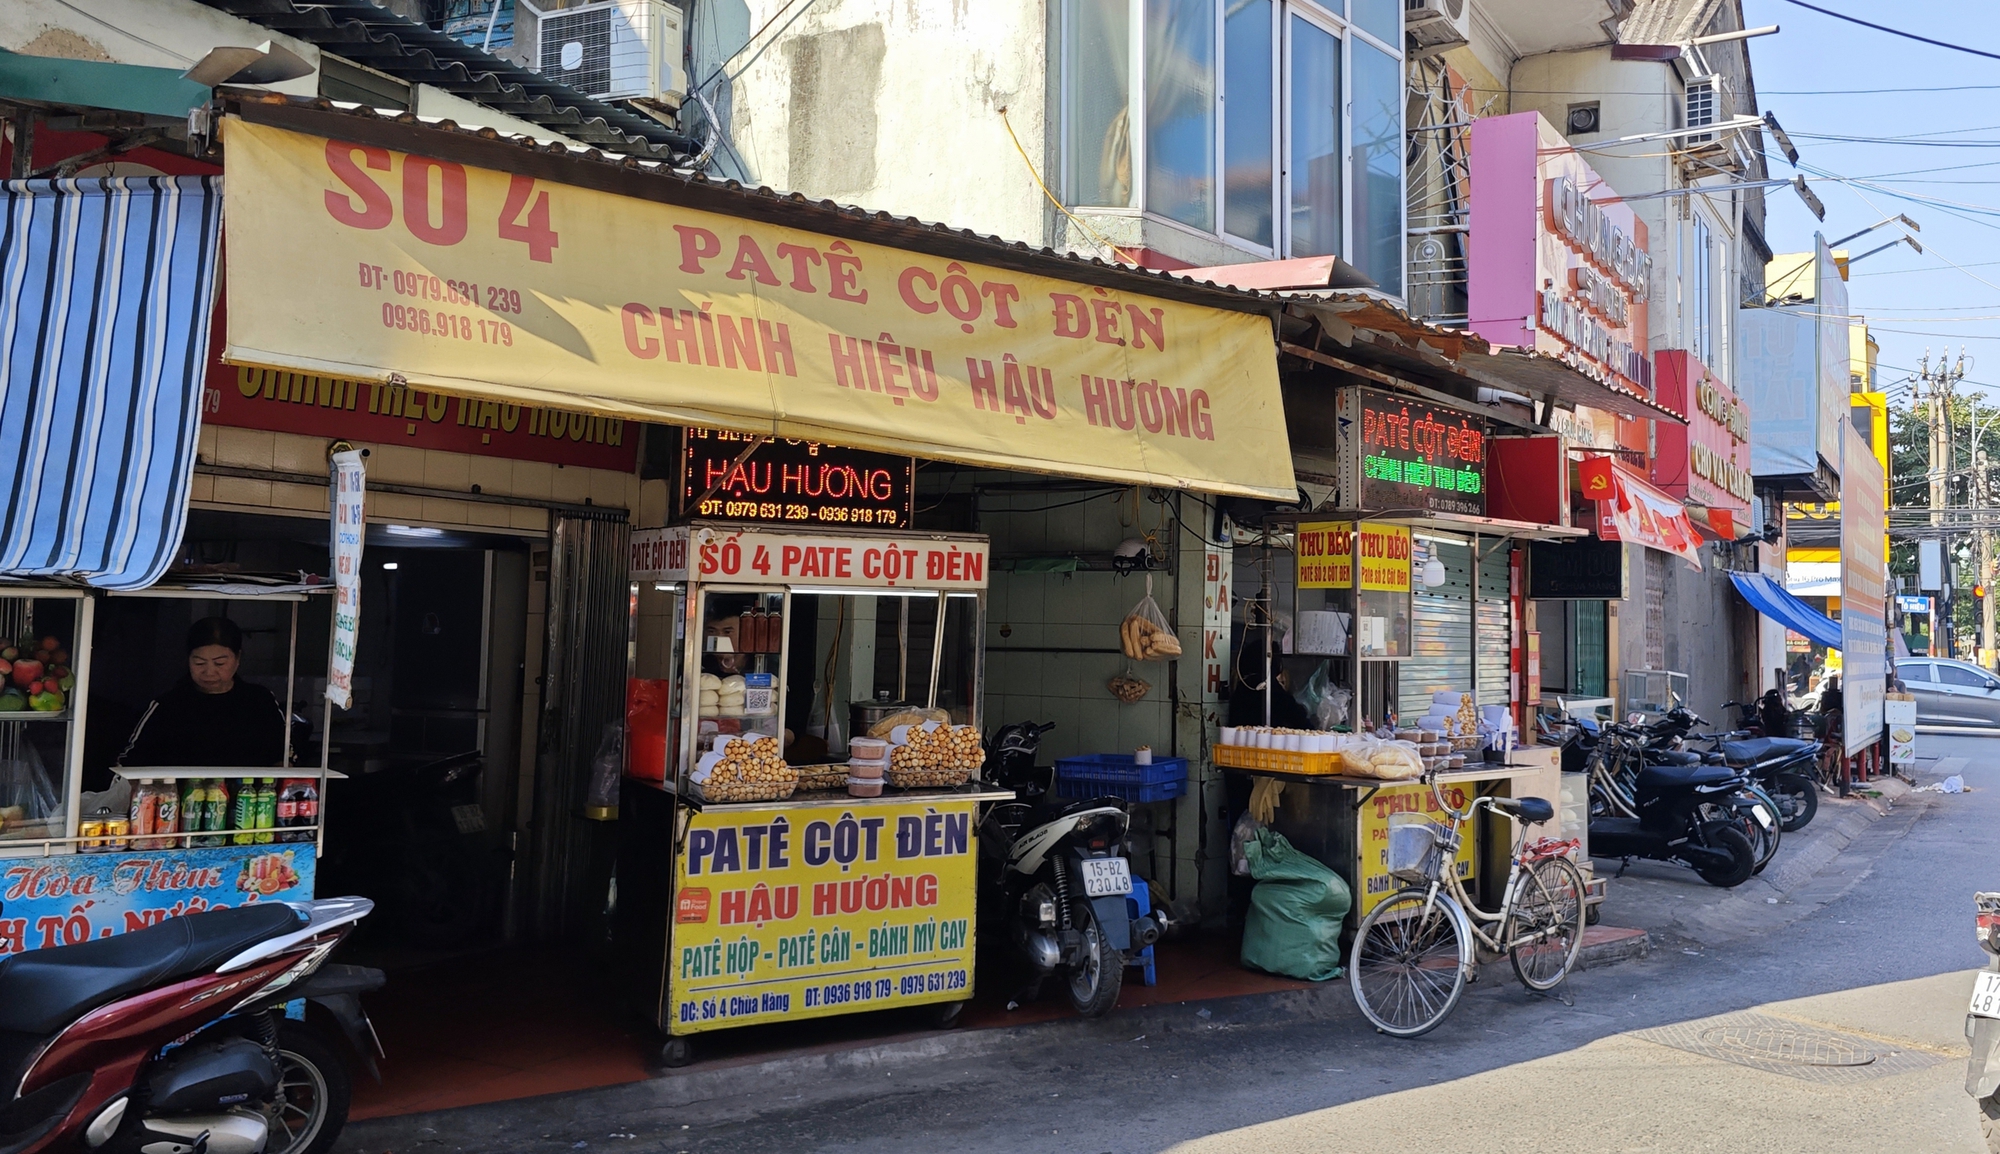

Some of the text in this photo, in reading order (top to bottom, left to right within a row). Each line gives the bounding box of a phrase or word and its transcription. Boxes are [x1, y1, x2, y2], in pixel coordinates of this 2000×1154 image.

[498, 174, 558, 263] 4
[1544, 176, 1624, 278] CHUNG
[393, 269, 479, 309] 0979.631
[487, 287, 522, 315] 239
[672, 224, 1165, 353] PATÊ CỘT ĐÈN
[1568, 267, 1629, 329] STORE
[382, 302, 513, 347] 0936.918 179
[620, 301, 1215, 441] CHÍNH HIỆU HẬU HƯƠNG
[1364, 407, 1482, 463] PATÊ CỘT ĐÈN
[783, 463, 892, 500] HƯƠNG
[1364, 450, 1402, 483] CHÍNH
[1404, 456, 1432, 491] HIỆU
[1433, 466, 1455, 492] THU
[1691, 439, 1712, 481] CHO
[1711, 451, 1728, 491] VAY
[700, 500, 723, 516] ĐT:
[726, 501, 757, 517] 0979
[760, 503, 782, 518] 631
[785, 504, 808, 520] 239
[819, 507, 848, 522] 0936
[851, 508, 873, 523] 918
[875, 509, 897, 524] 179
[652, 535, 668, 575] CỘT
[669, 531, 687, 570] ĐÈN
[699, 531, 983, 586] SỐ 4 PATE CỘT ĐÈN
[1300, 525, 1351, 556] THU BÉO
[1361, 529, 1408, 560] THU BÉO
[1323, 566, 1327, 582] 2
[159, 806, 176, 820] C2
[1373, 792, 1419, 819] THU
[687, 808, 969, 876] PATÊ CỘT ĐÈN
[112, 858, 225, 896] Thêm
[1088, 876, 1130, 894] 230.48
[1090, 860, 1123, 877] 15-B2
[719, 873, 939, 928] HẬU HƯƠNG
[682, 938, 721, 979] PATÊ
[726, 936, 760, 979] HỘP
[778, 928, 816, 968] PATÊ
[820, 926, 851, 964] CÂN
[869, 921, 909, 958] BÁNH
[913, 917, 936, 953] MỲ
[940, 919, 968, 950] CAY
[680, 1001, 700, 1023] ĐC:
[702, 997, 717, 1021] Số
[719, 998, 727, 1018] 4
[761, 992, 790, 1014] Hàng
[804, 987, 822, 1008] ĐT:
[823, 984, 852, 1006] 0936
[853, 981, 873, 1002] 918
[874, 979, 892, 999] 179
[900, 974, 926, 996] 0979
[927, 972, 947, 993] 631
[947, 970, 967, 990] 239
